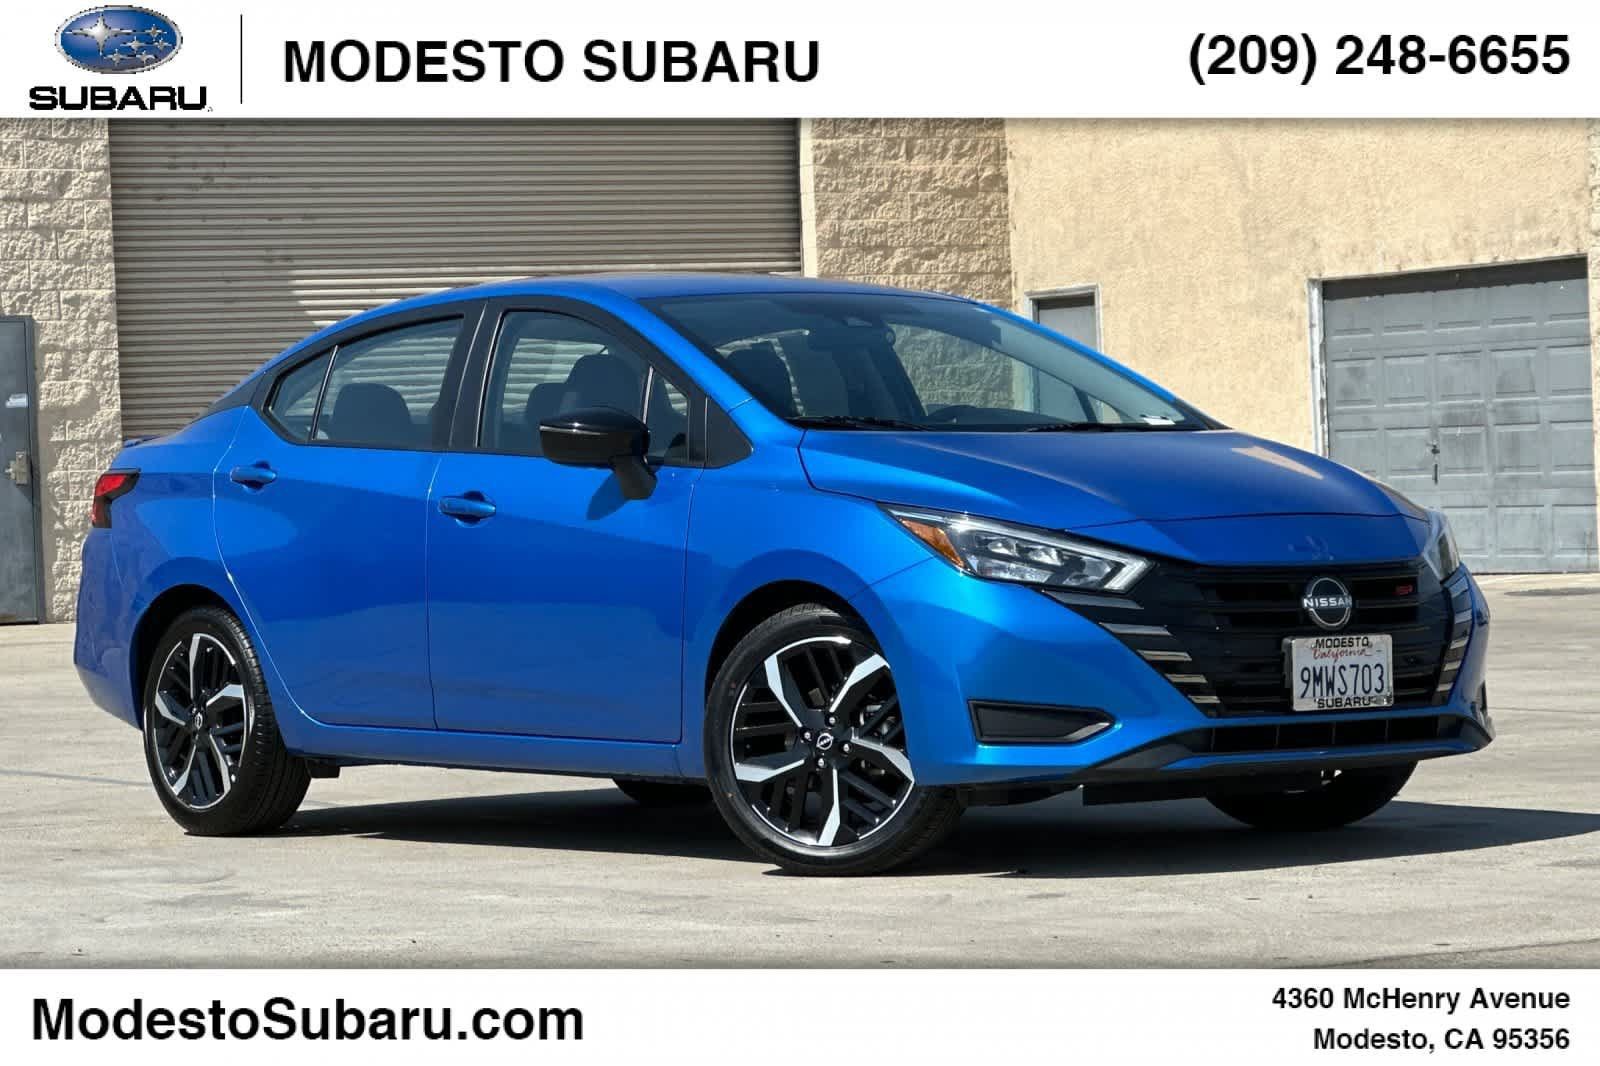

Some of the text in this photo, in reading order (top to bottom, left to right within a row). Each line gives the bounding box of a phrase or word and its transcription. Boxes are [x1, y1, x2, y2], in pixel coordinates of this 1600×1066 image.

[1303, 597, 1352, 608] NISSAN
[1315, 637, 1369, 648] MODESTO
[1312, 648, 1373, 663] California
[1300, 663, 1384, 699] 9MWS703
[1317, 697, 1371, 708] SUBARU
